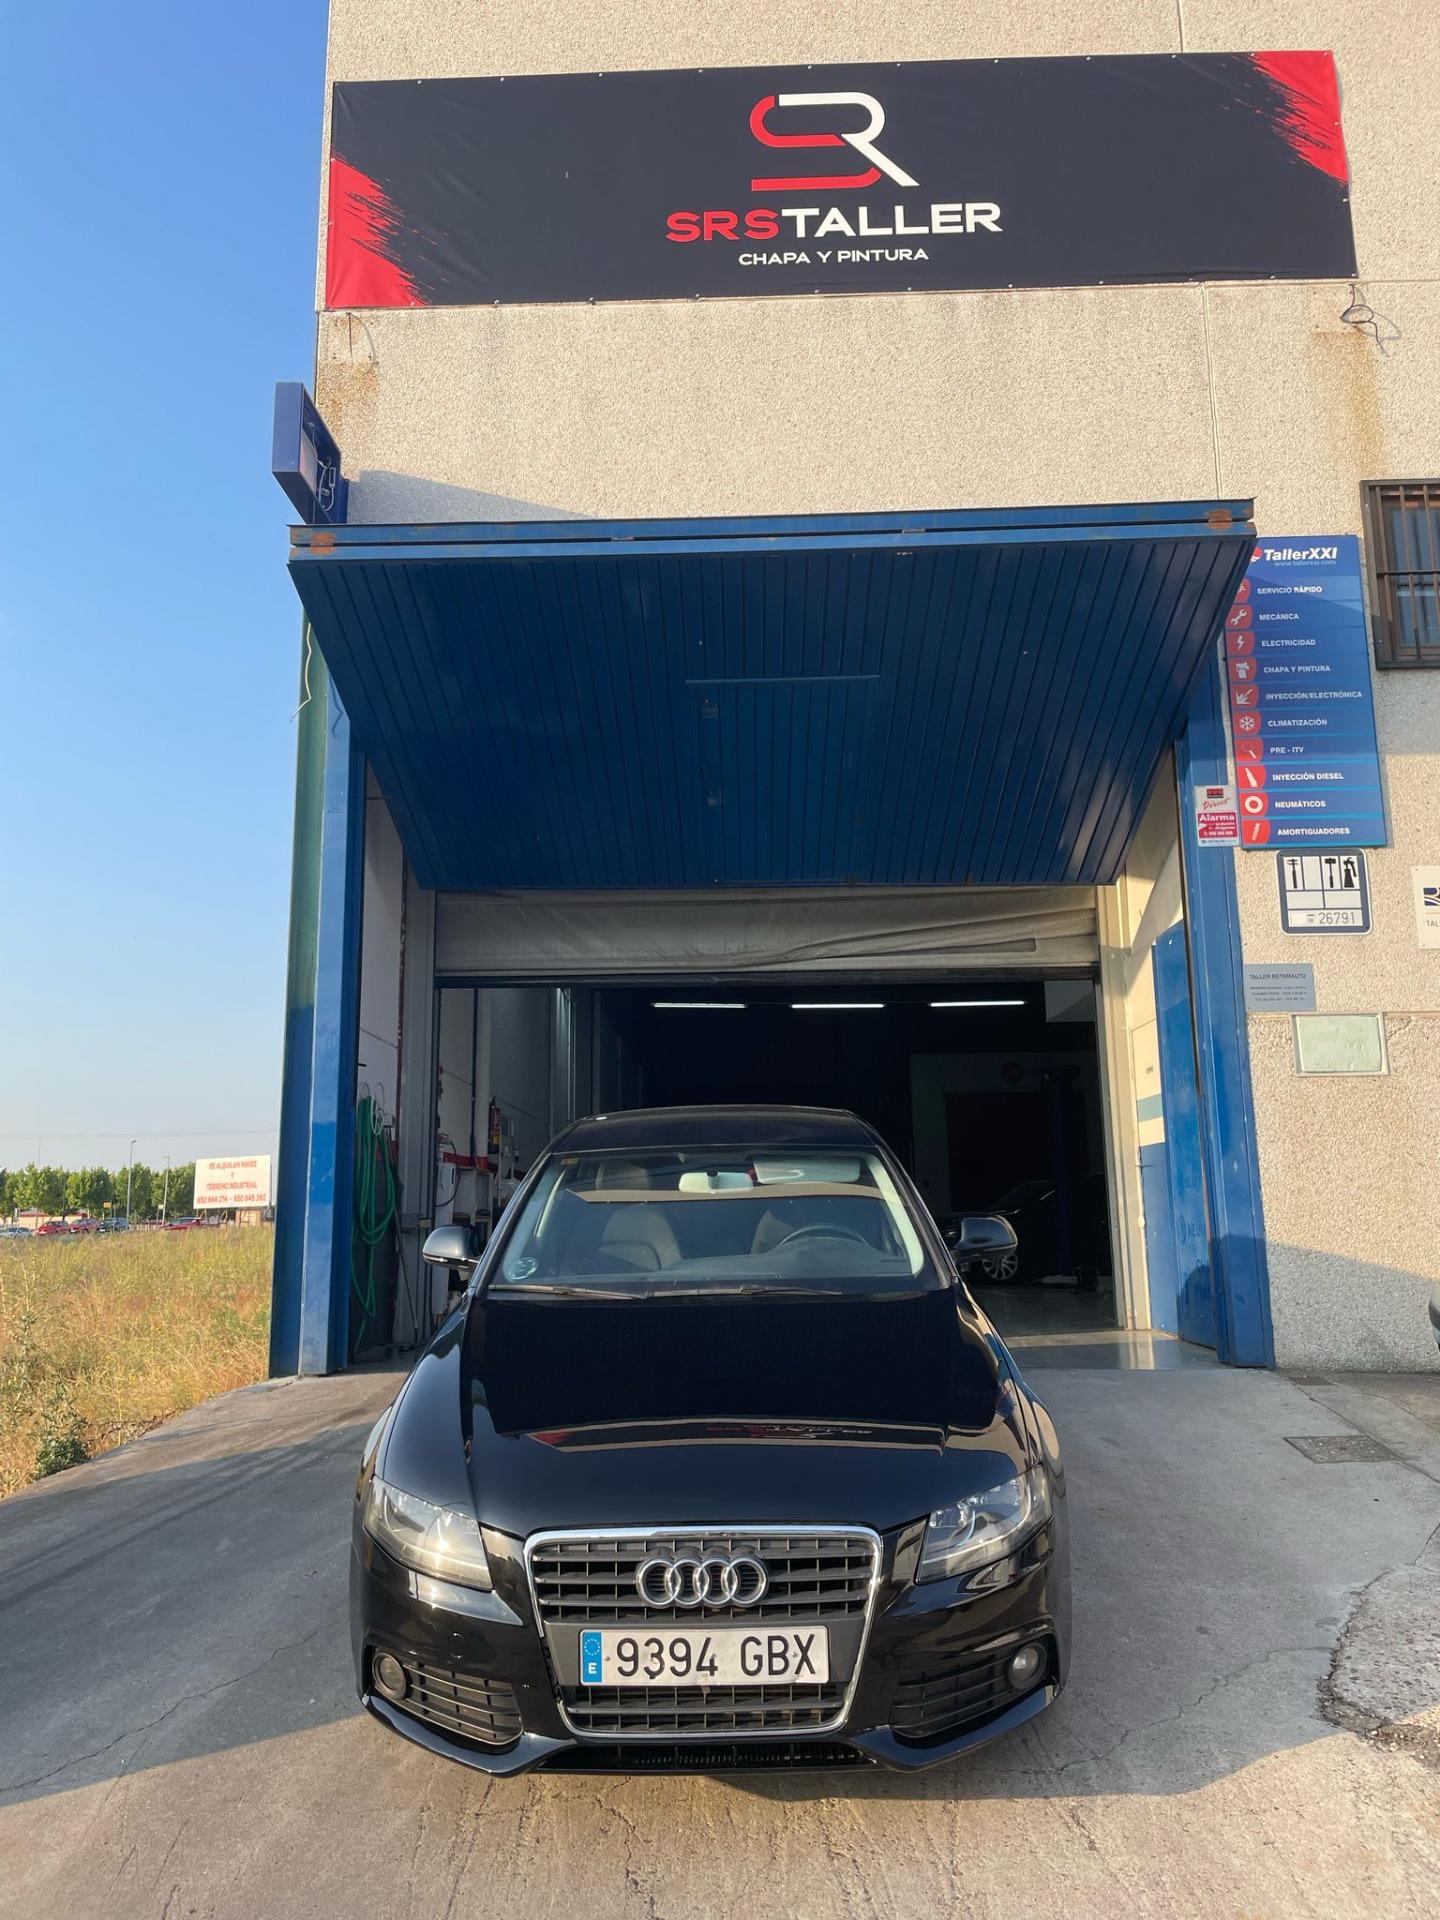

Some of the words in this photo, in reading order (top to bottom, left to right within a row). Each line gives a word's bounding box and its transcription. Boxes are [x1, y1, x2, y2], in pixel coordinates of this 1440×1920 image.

[665, 201, 1004, 242] SRSTALLER
[738, 251, 811, 266] CHAPA
[816, 250, 832, 264] Y
[837, 248, 930, 263] PINTURA
[1263, 547, 1338, 561] TallerXXI
[1257, 587, 1292, 595] SERVICIO
[1293, 585, 1323, 594] RÁPIDO
[1259, 612, 1300, 621] MECÁNICA
[1261, 639, 1316, 647] ELECTRICIDAD
[1263, 666, 1290, 674] CHAPA
[1297, 665, 1331, 673] PINTURA
[1267, 717, 1328, 727] CLIMATIZACIÓN
[1270, 746, 1286, 754] PRE
[1292, 746, 1304, 754] ITV
[1272, 772, 1315, 781] INYECCIÓN
[1316, 772, 1344, 780] DIESEL
[1274, 800, 1327, 808] NEUMÁTICOS
[1199, 813, 1235, 822] Alarma
[1277, 827, 1350, 836] AMORTIGUADORES
[1318, 911, 1355, 925] 26791
[1426, 919, 1440, 928] TAL
[616, 1637, 718, 1678] 9394
[740, 1634, 816, 1676] GBX
[587, 1663, 598, 1674] E
